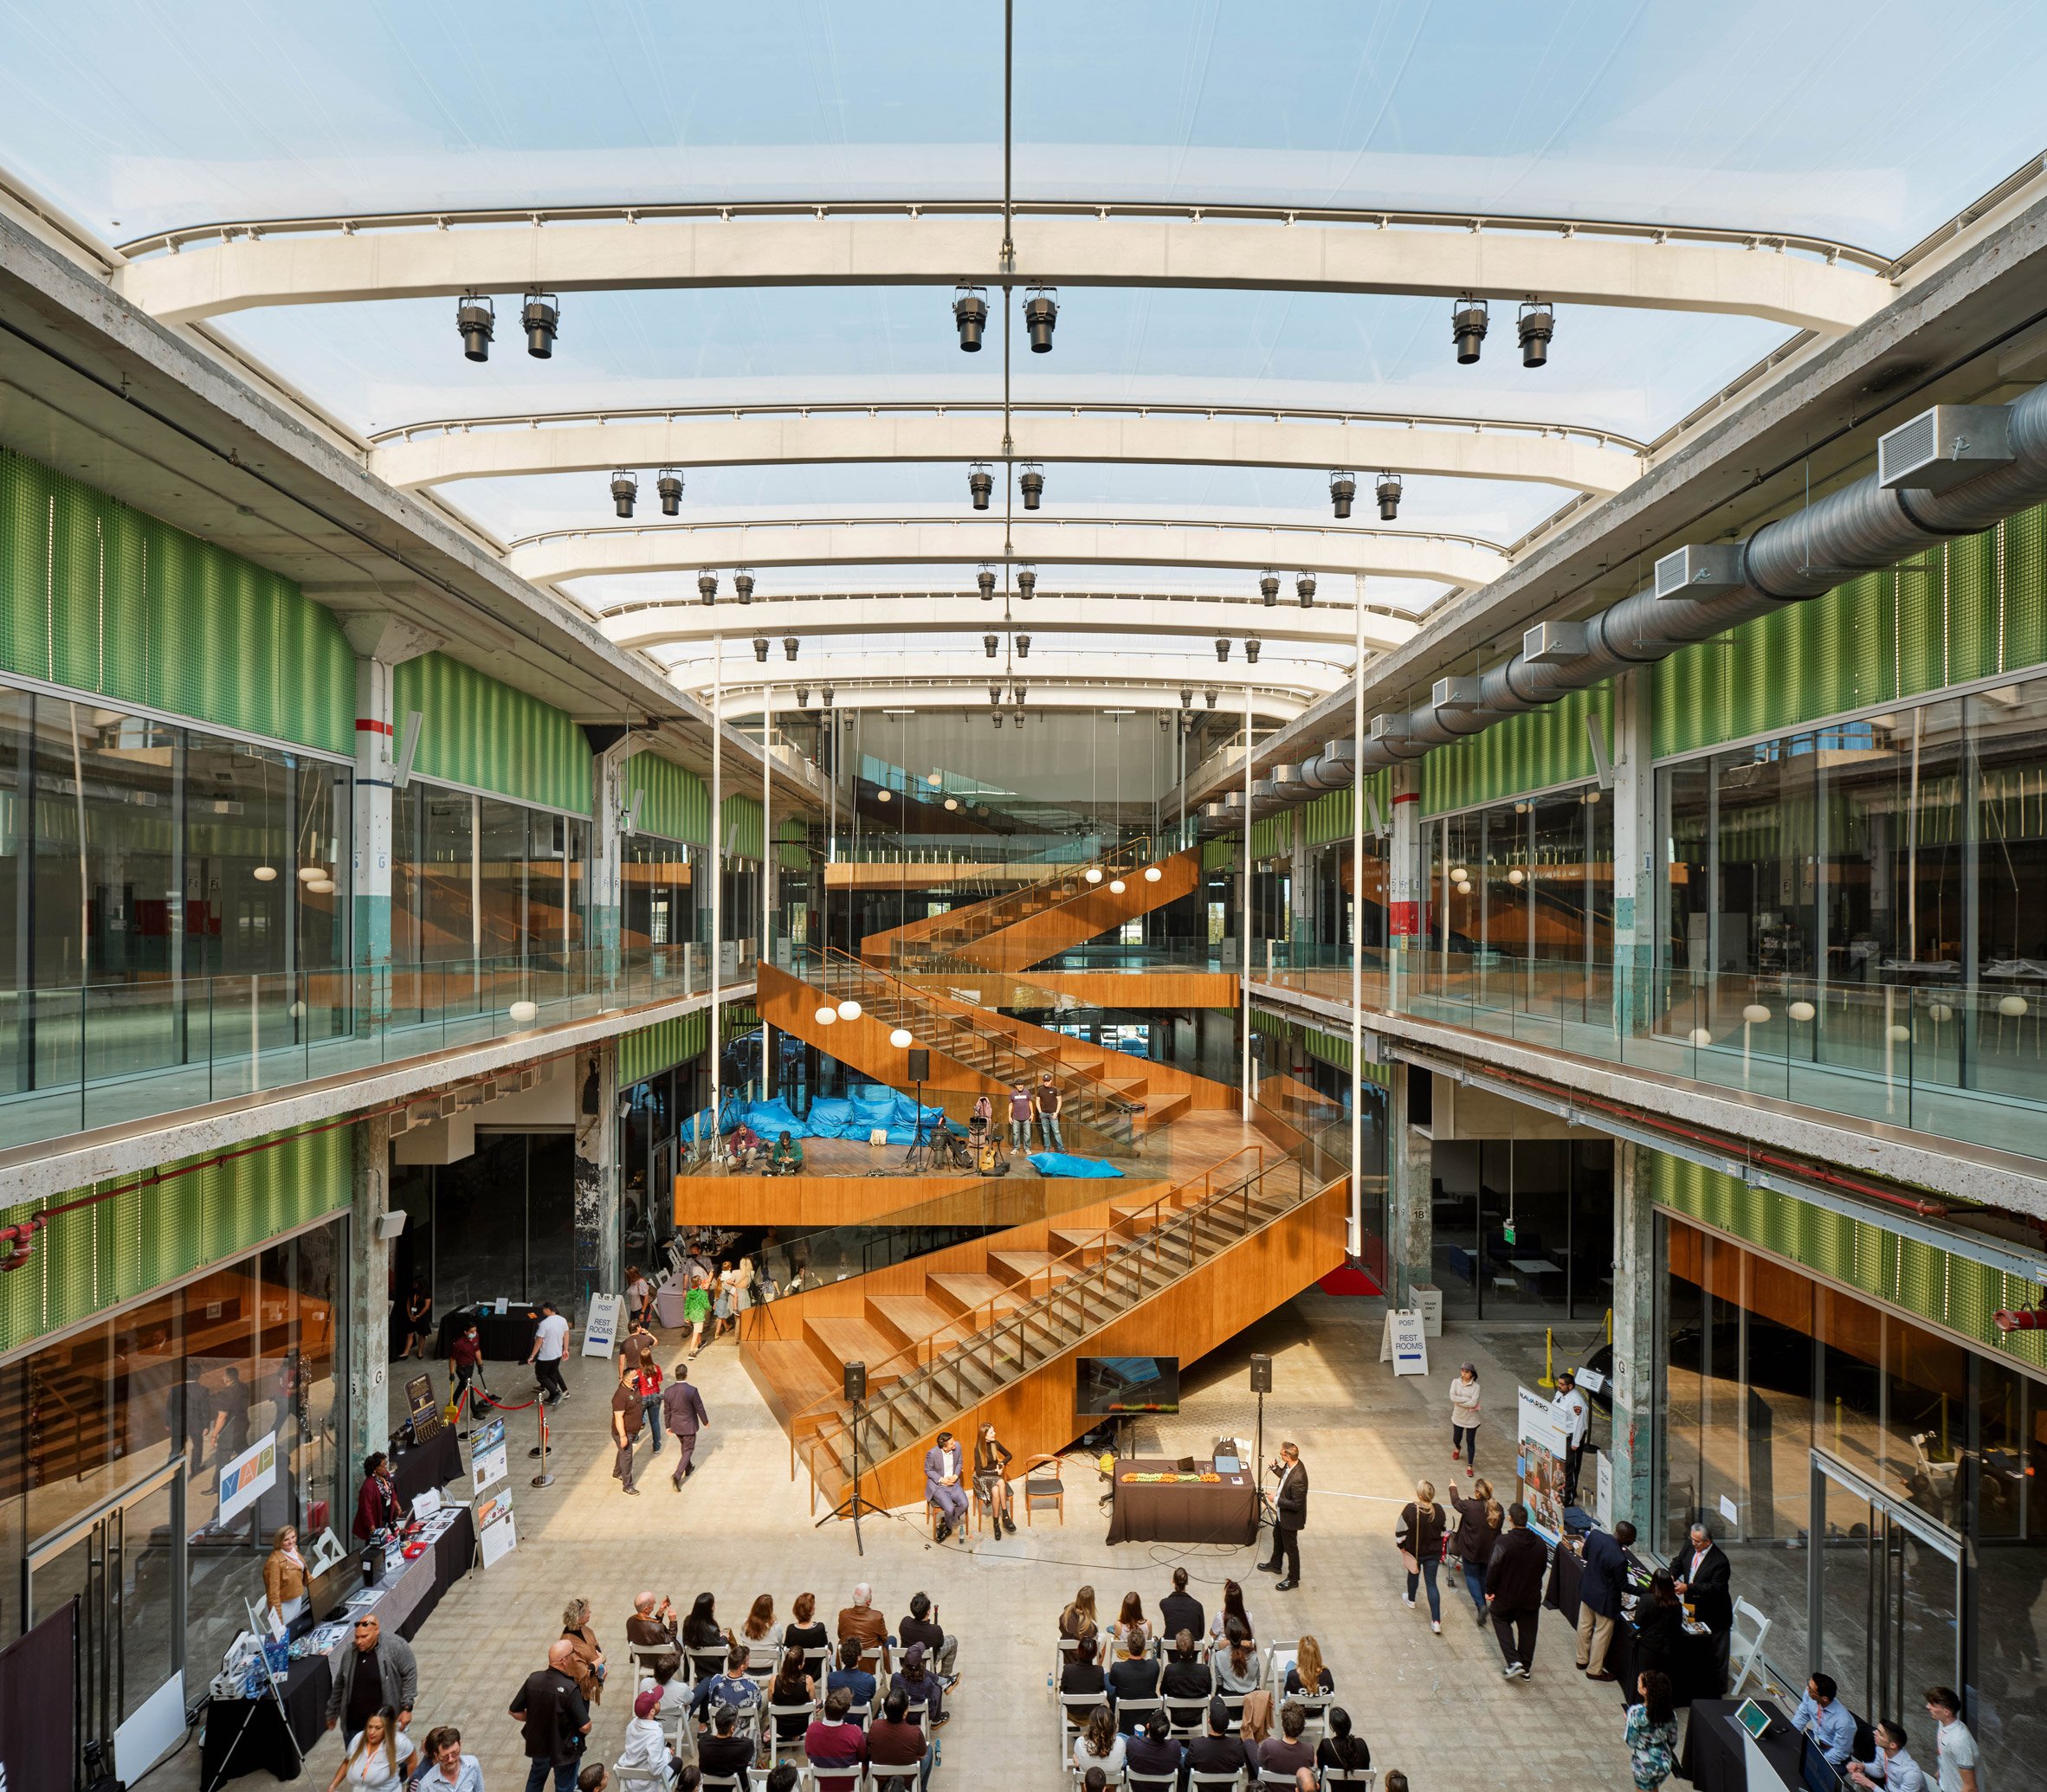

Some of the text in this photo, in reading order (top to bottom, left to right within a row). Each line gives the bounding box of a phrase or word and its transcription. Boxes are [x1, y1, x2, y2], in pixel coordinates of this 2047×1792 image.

[378, 856, 385, 869] G
[1413, 1210, 1424, 1219] 18
[594, 1318, 610, 1326] REST
[589, 1325, 613, 1335] ROOMS
[1618, 1360, 1625, 1375] G
[376, 1370, 382, 1384] G
[1520, 1392, 1548, 1412] NAVARRO
[226, 1447, 272, 1496] YAP
